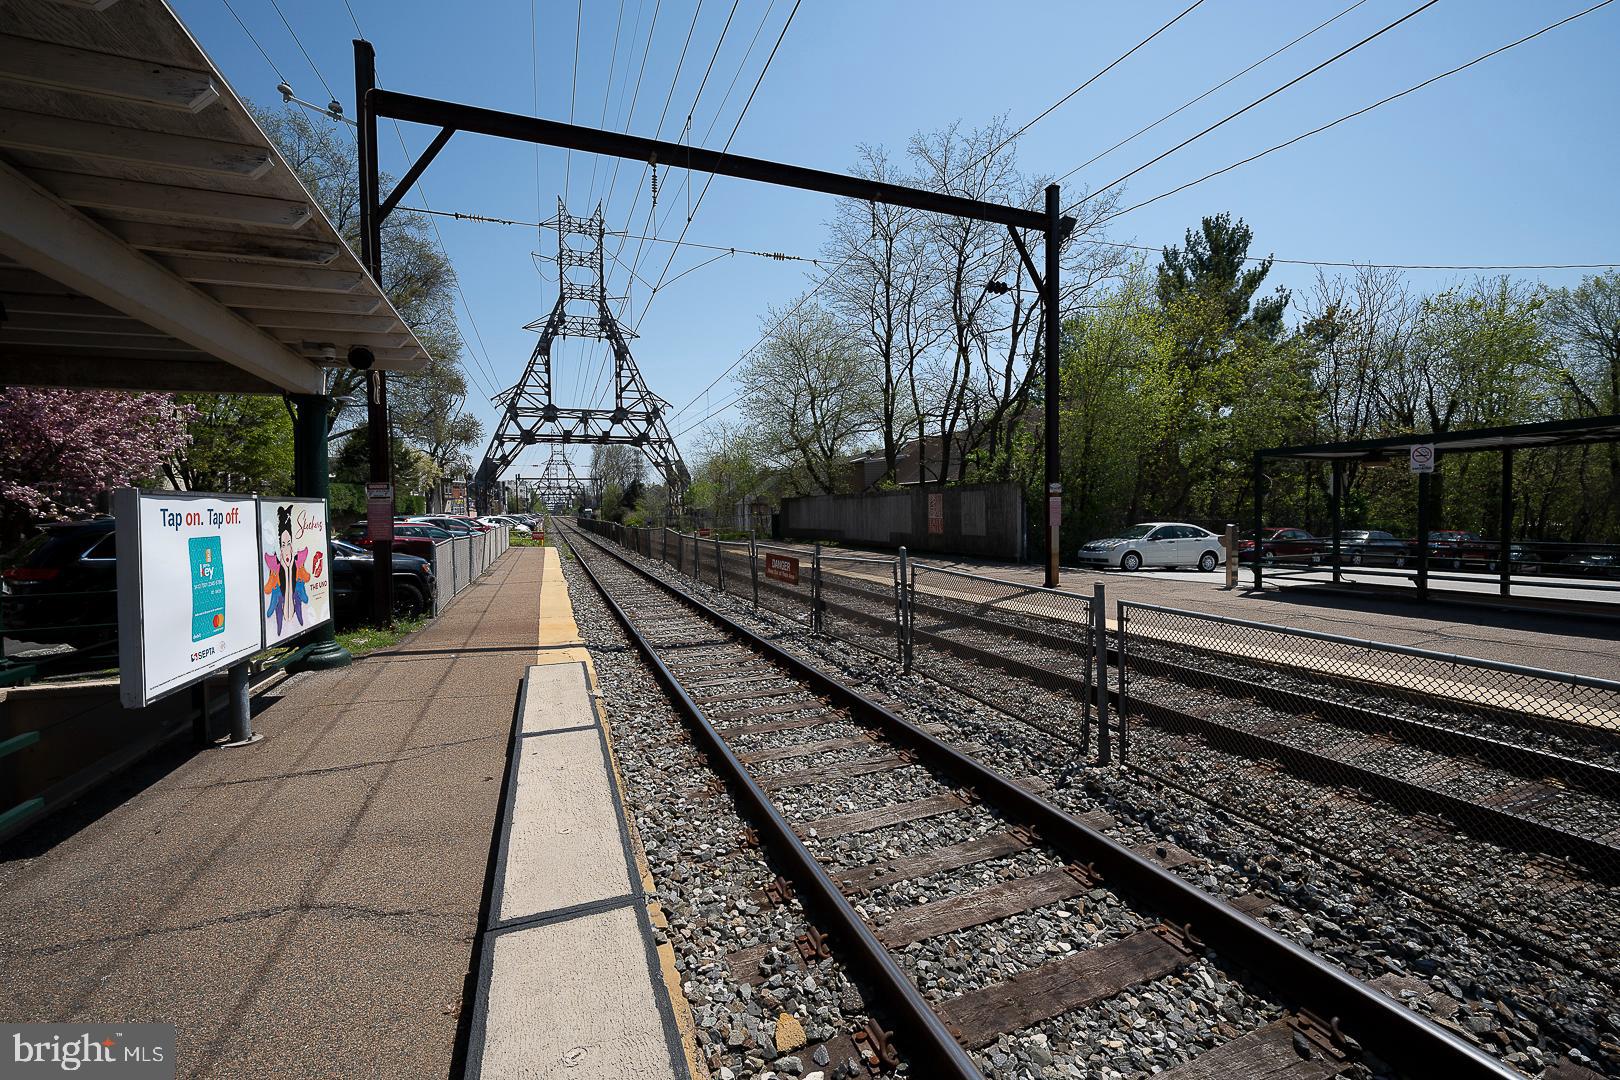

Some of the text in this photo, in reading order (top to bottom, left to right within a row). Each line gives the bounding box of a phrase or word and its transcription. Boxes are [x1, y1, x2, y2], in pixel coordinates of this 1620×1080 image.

[160, 507, 241, 531] Tap on. Tap off.
[199, 564, 214, 580] key
[772, 559, 791, 572] DANGER
[310, 583, 318, 591] THE
[198, 647, 216, 660] SEPTA
